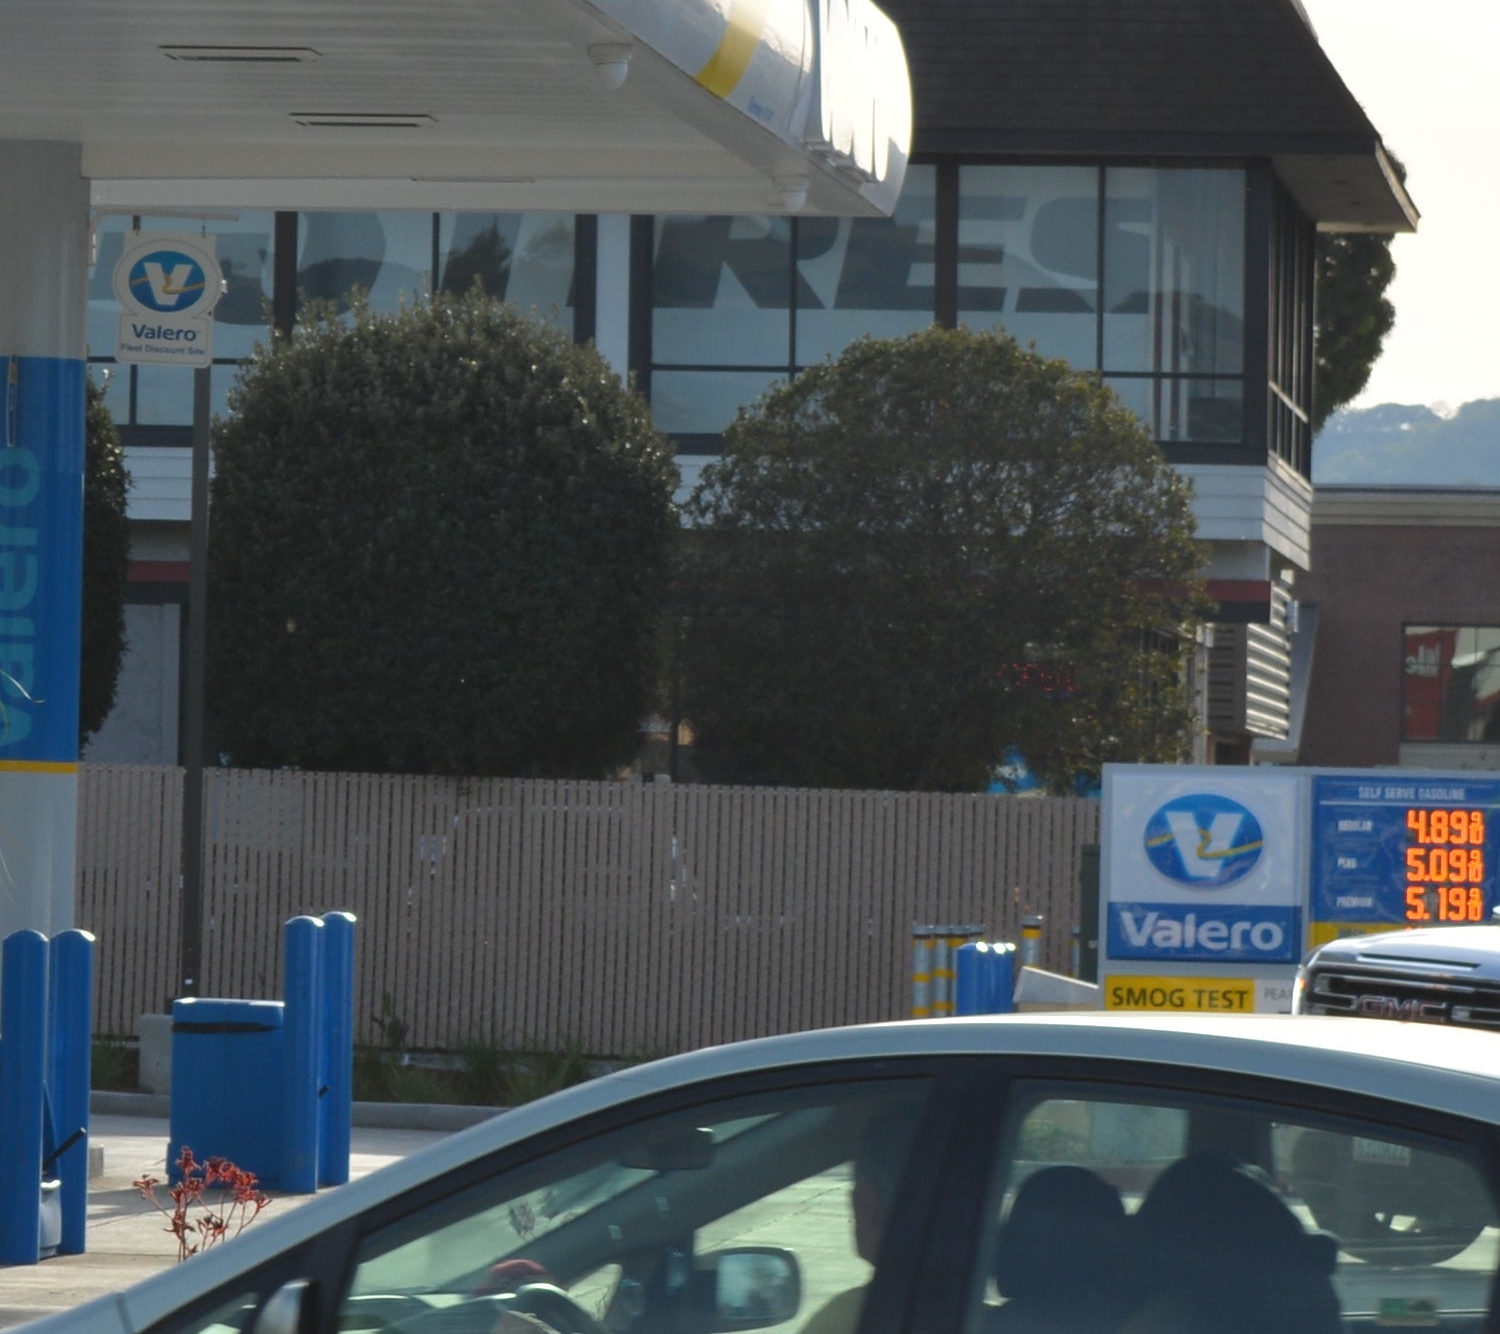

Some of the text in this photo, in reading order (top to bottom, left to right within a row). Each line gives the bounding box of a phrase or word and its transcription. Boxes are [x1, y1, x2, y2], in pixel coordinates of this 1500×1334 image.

[132, 323, 197, 342] Valero
[145, 344, 185, 355] Discount
[187, 346, 205, 355] Site
[1358, 786, 1466, 801] SELF SERVE GASOLINE
[1120, 910, 1284, 951] Valero
[1112, 987, 1250, 1010] SMOG TEST
[1357, 994, 1447, 1023] GMC
